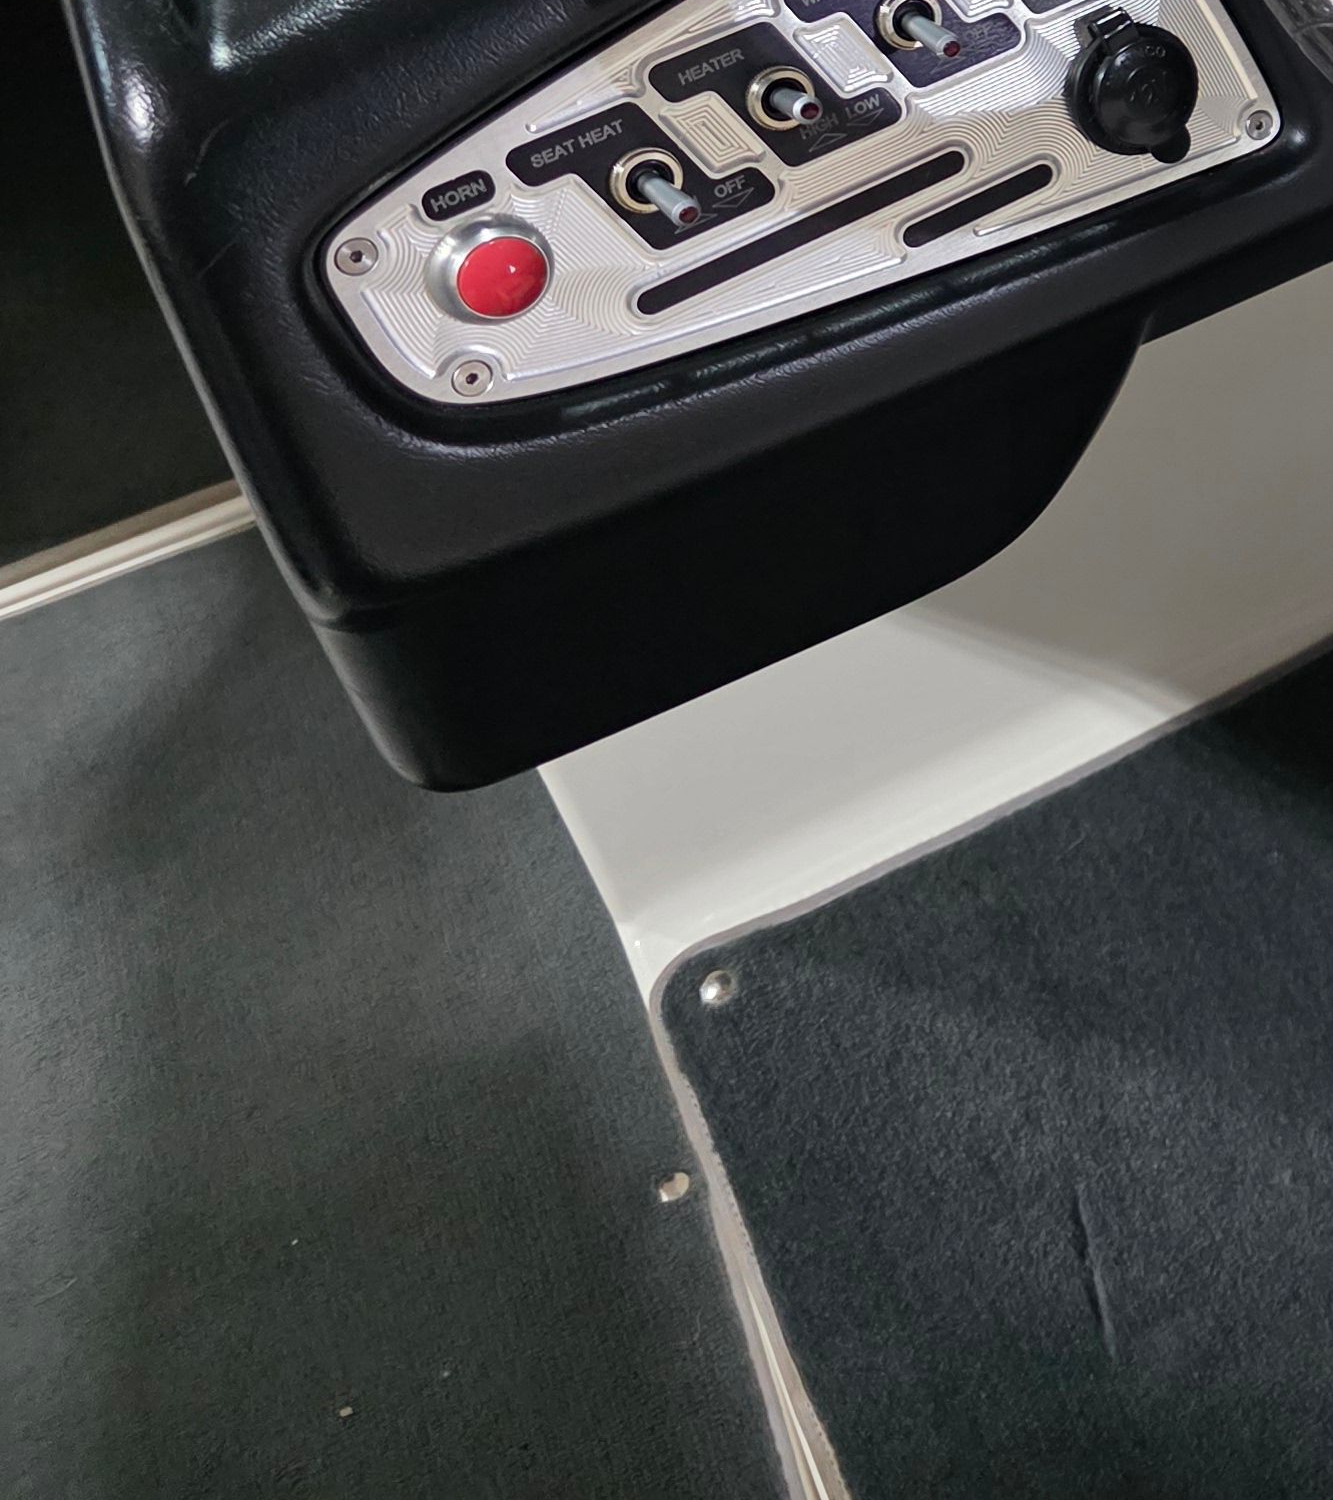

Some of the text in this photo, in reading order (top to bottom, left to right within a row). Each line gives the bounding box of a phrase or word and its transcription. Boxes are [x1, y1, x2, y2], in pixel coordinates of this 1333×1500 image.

[677, 48, 745, 87] HEATER
[800, 94, 881, 140] HIGH LOW
[530, 119, 625, 169] SEAT HEAT
[430, 178, 486, 215] HORN
[713, 175, 746, 199] OFF
